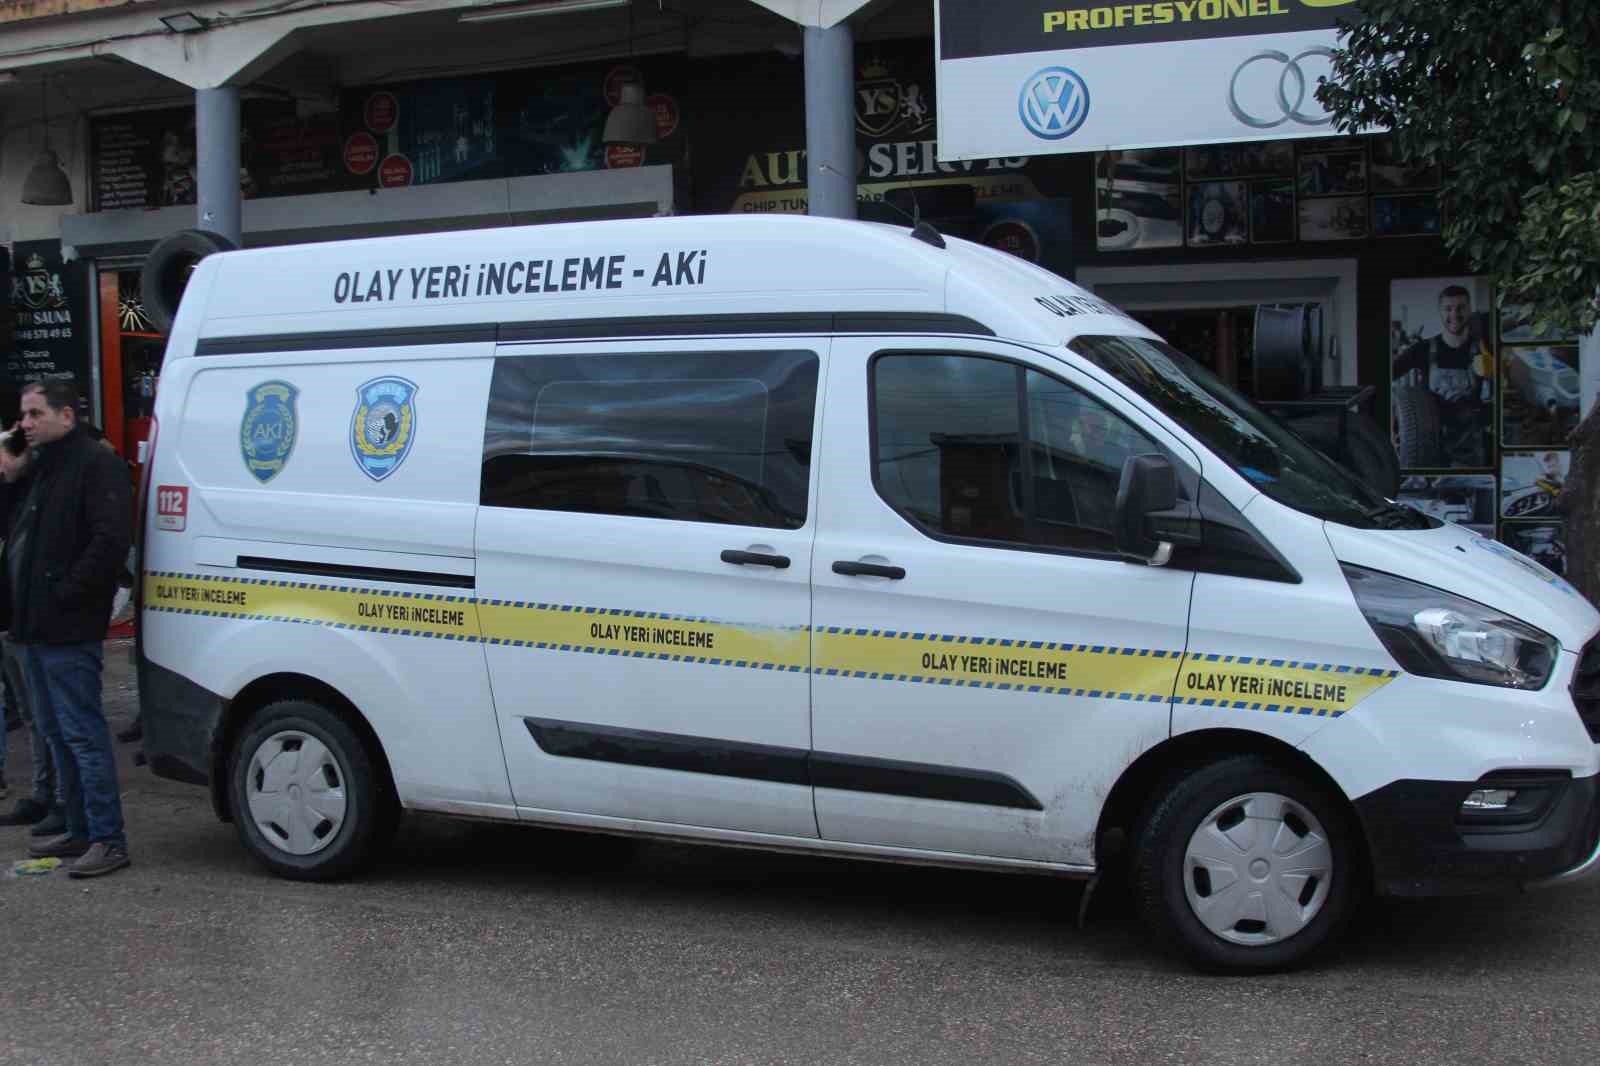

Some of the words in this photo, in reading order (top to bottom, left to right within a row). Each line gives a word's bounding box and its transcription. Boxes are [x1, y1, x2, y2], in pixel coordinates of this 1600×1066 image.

[1043, 0, 1289, 32] PROFESYONEL
[334, 268, 403, 304] OLAY
[159, 490, 184, 513] 112
[156, 584, 178, 599] OLAY
[358, 602, 385, 618] OLAY
[590, 622, 621, 640] OLAY
[922, 652, 957, 671] OLAY
[1187, 672, 1226, 691] OLAY
